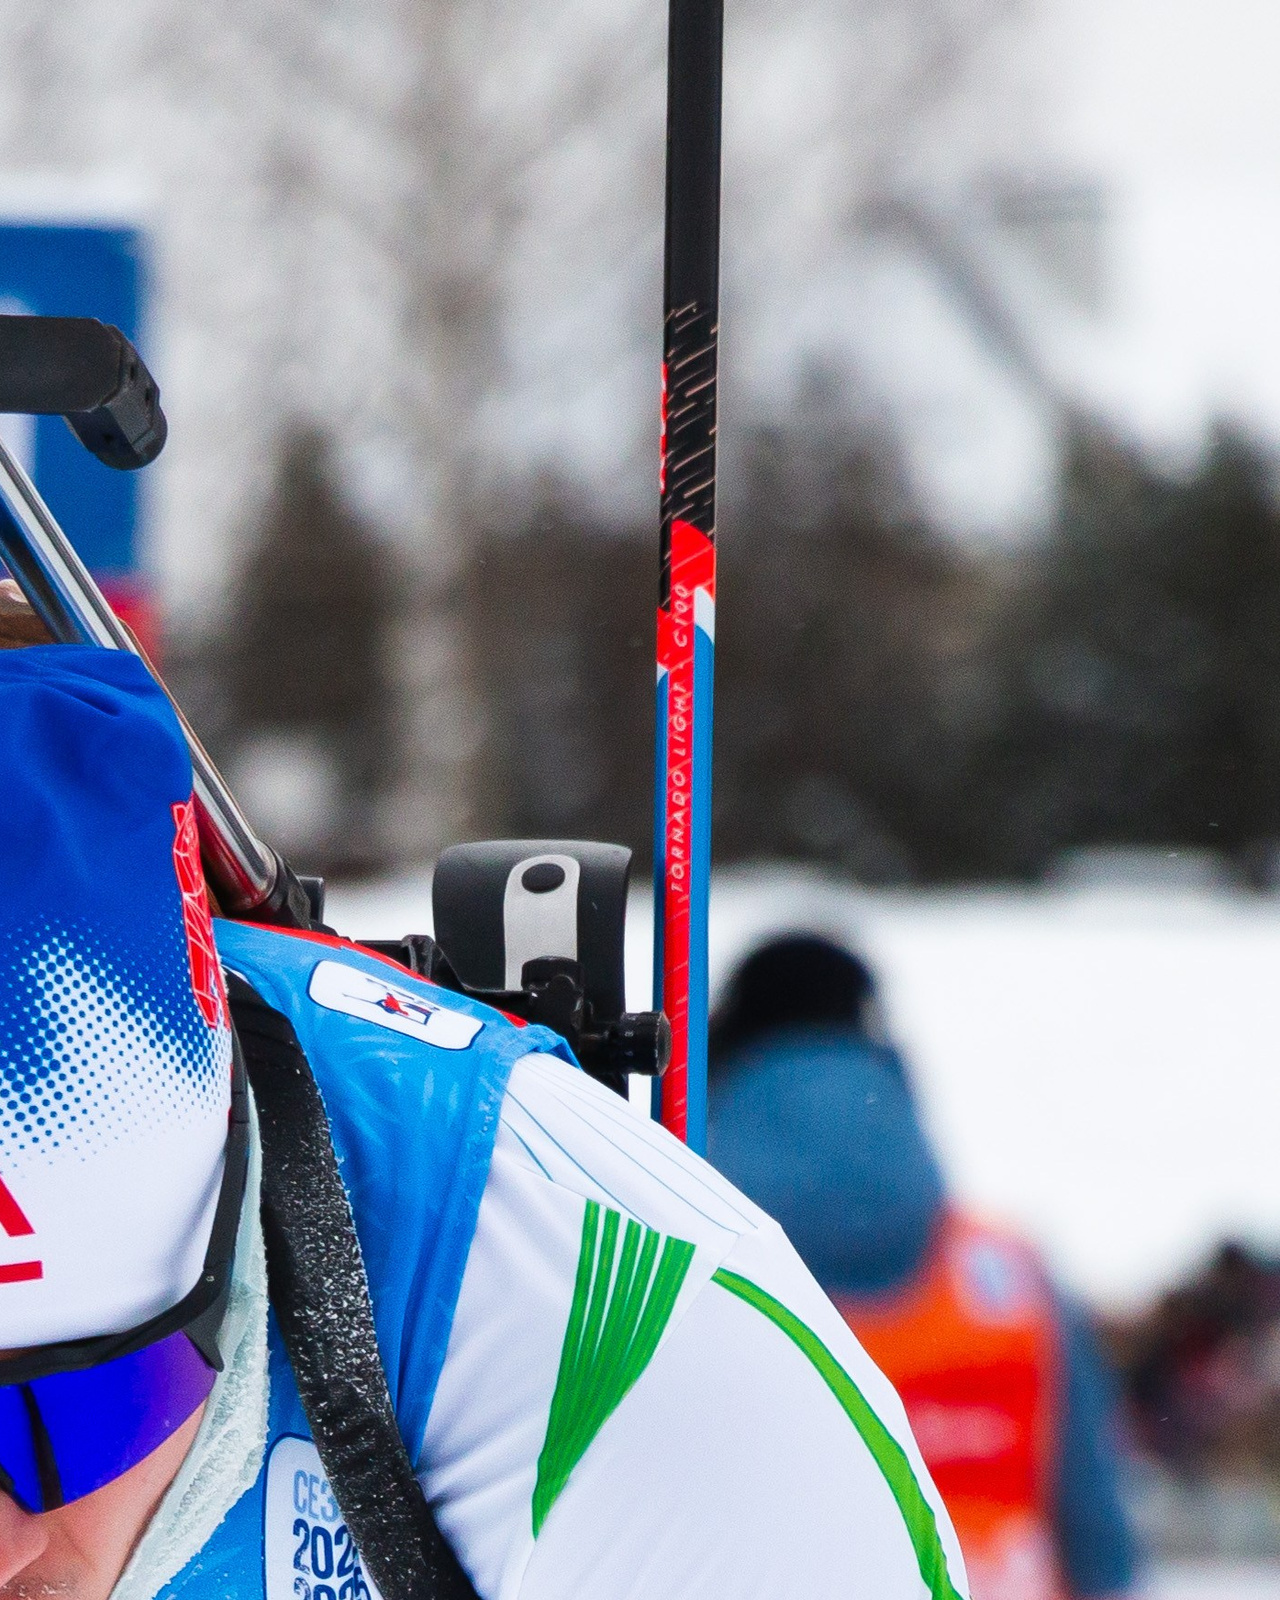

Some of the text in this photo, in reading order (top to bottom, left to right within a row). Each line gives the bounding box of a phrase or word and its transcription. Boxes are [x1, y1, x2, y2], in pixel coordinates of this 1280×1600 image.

[671, 584, 690, 893] TORNADO LIGHT C100
[293, 1469, 344, 1523] СЕЗ
[292, 1517, 360, 1580] 202
